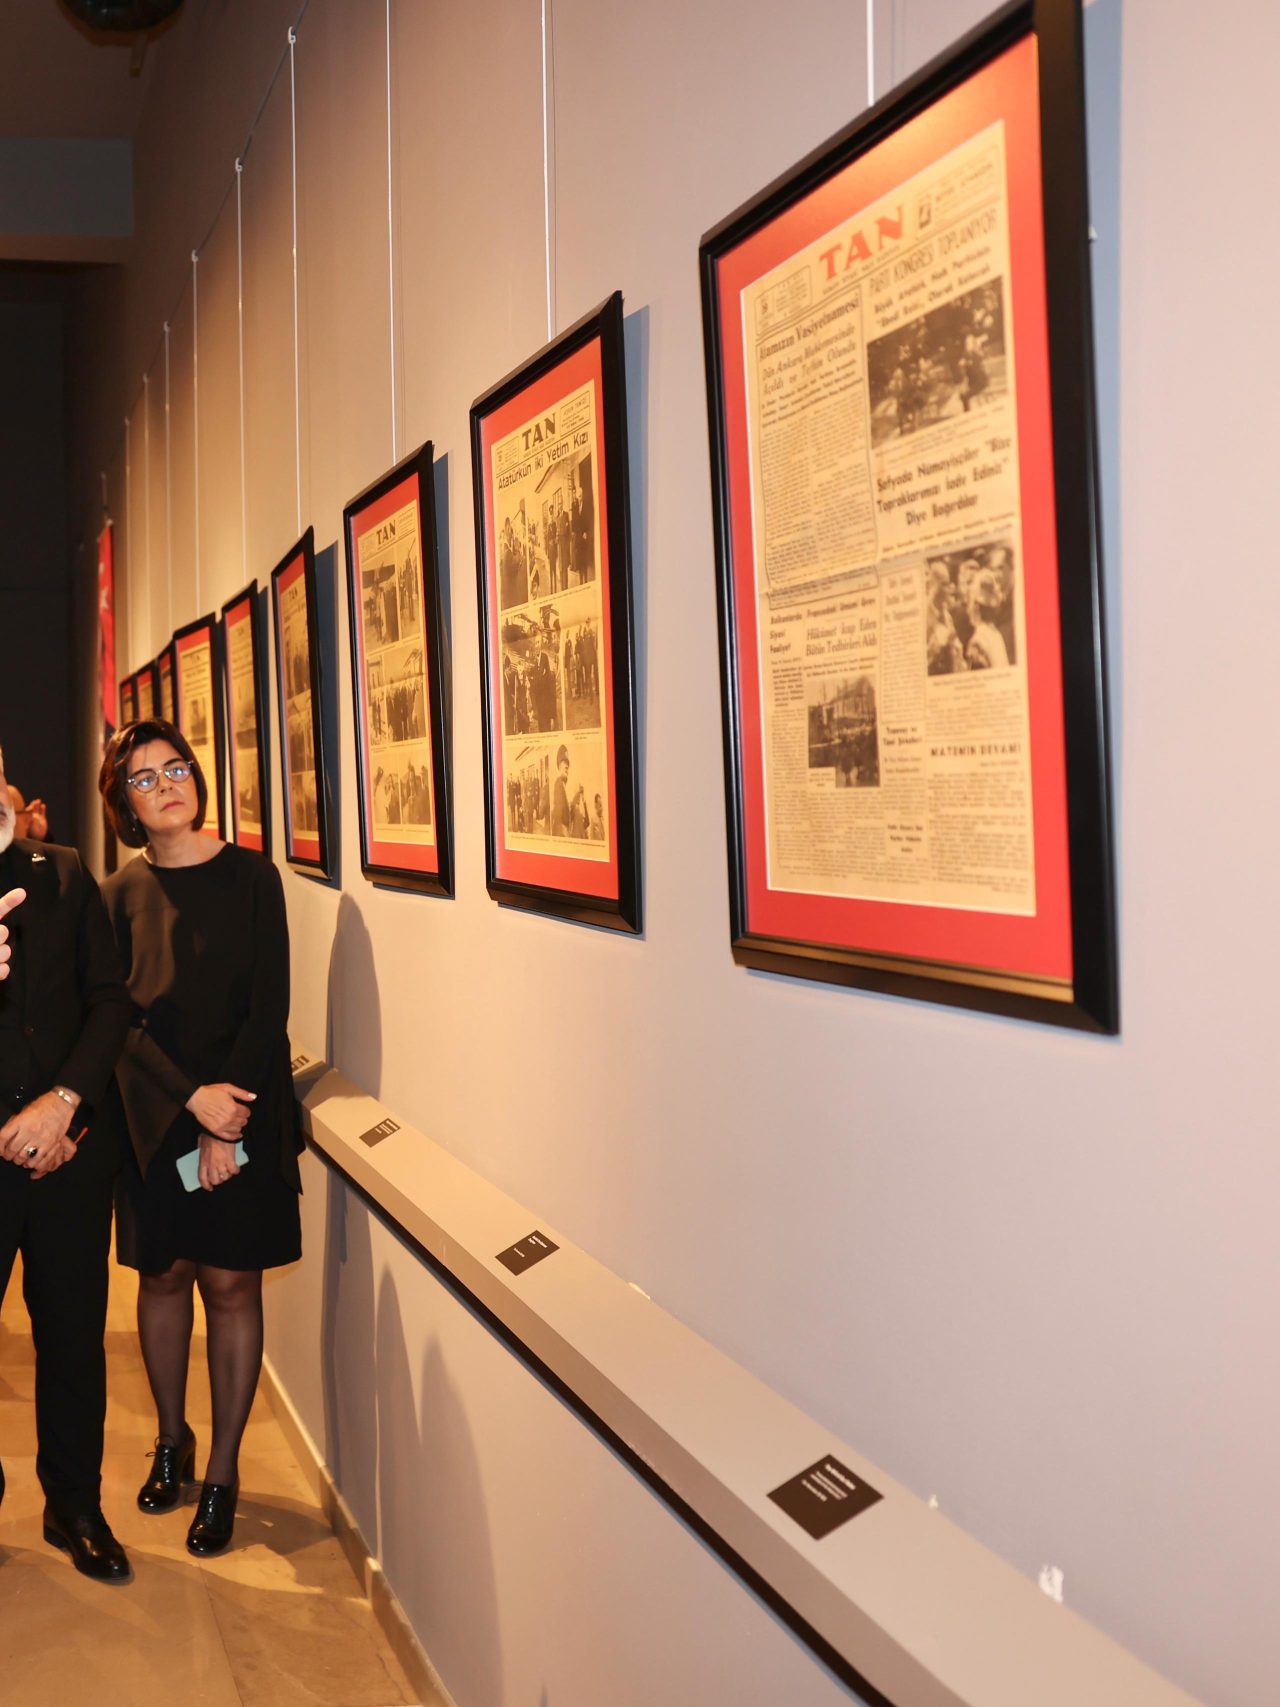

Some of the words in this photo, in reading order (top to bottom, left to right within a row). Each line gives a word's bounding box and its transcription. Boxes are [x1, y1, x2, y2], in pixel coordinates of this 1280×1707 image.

[819, 204, 904, 281] TAN
[796, 292, 859, 340] Vasiyetnamesi
[522, 412, 556, 451] TAN
[498, 462, 532, 490] Atatürkün
[546, 442, 570, 463] Yetim
[573, 431, 589, 449] Kızı
[877, 470, 913, 493] Sofyada
[376, 520, 396, 545] TAN
[906, 510, 928, 527] Diye
